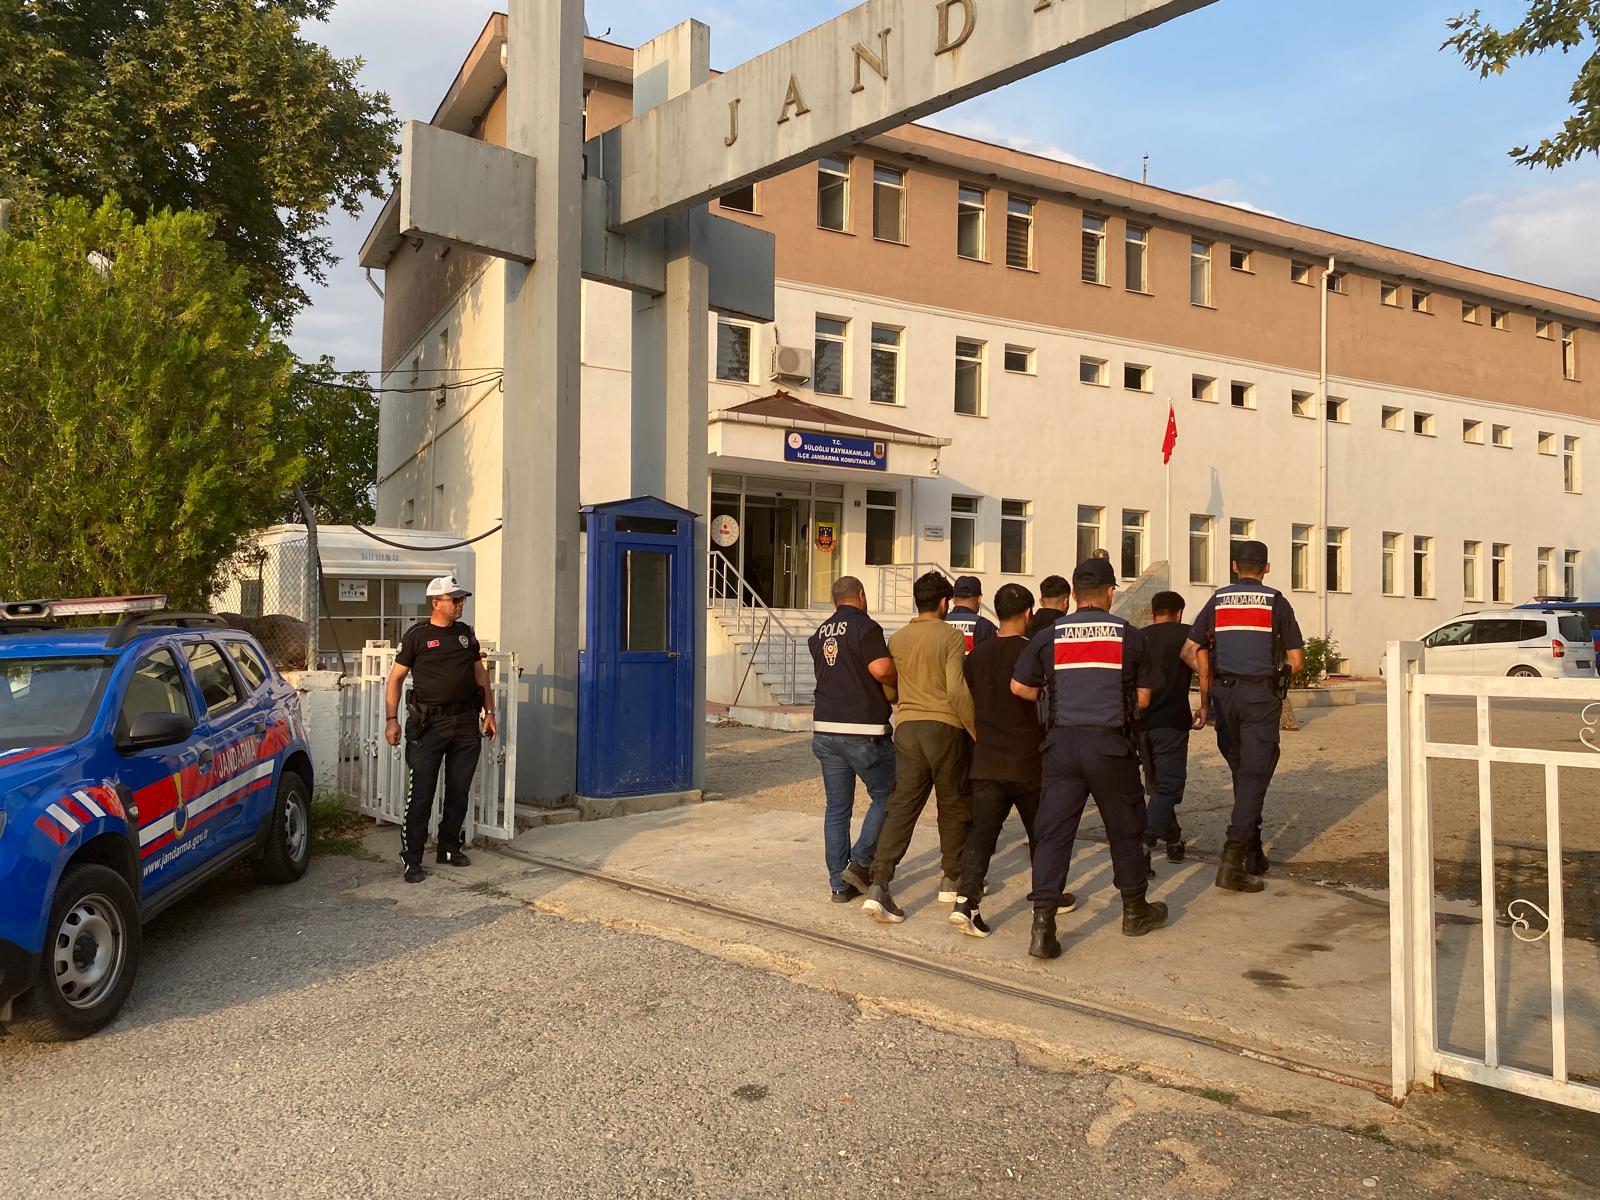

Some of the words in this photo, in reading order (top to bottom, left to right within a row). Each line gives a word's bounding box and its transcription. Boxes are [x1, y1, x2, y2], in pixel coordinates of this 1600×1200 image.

[724, 0, 1052, 147] JAND
[797, 451, 810, 460] İLÇE
[810, 453, 839, 462] JANDARMA
[1220, 594, 1267, 606] JANDARMA
[818, 621, 848, 639] POLIS
[1061, 626, 1118, 639] JANDARMA
[218, 738, 258, 778] JANDARMA
[143, 829, 209, 877] www.jandarma.gov.tr
